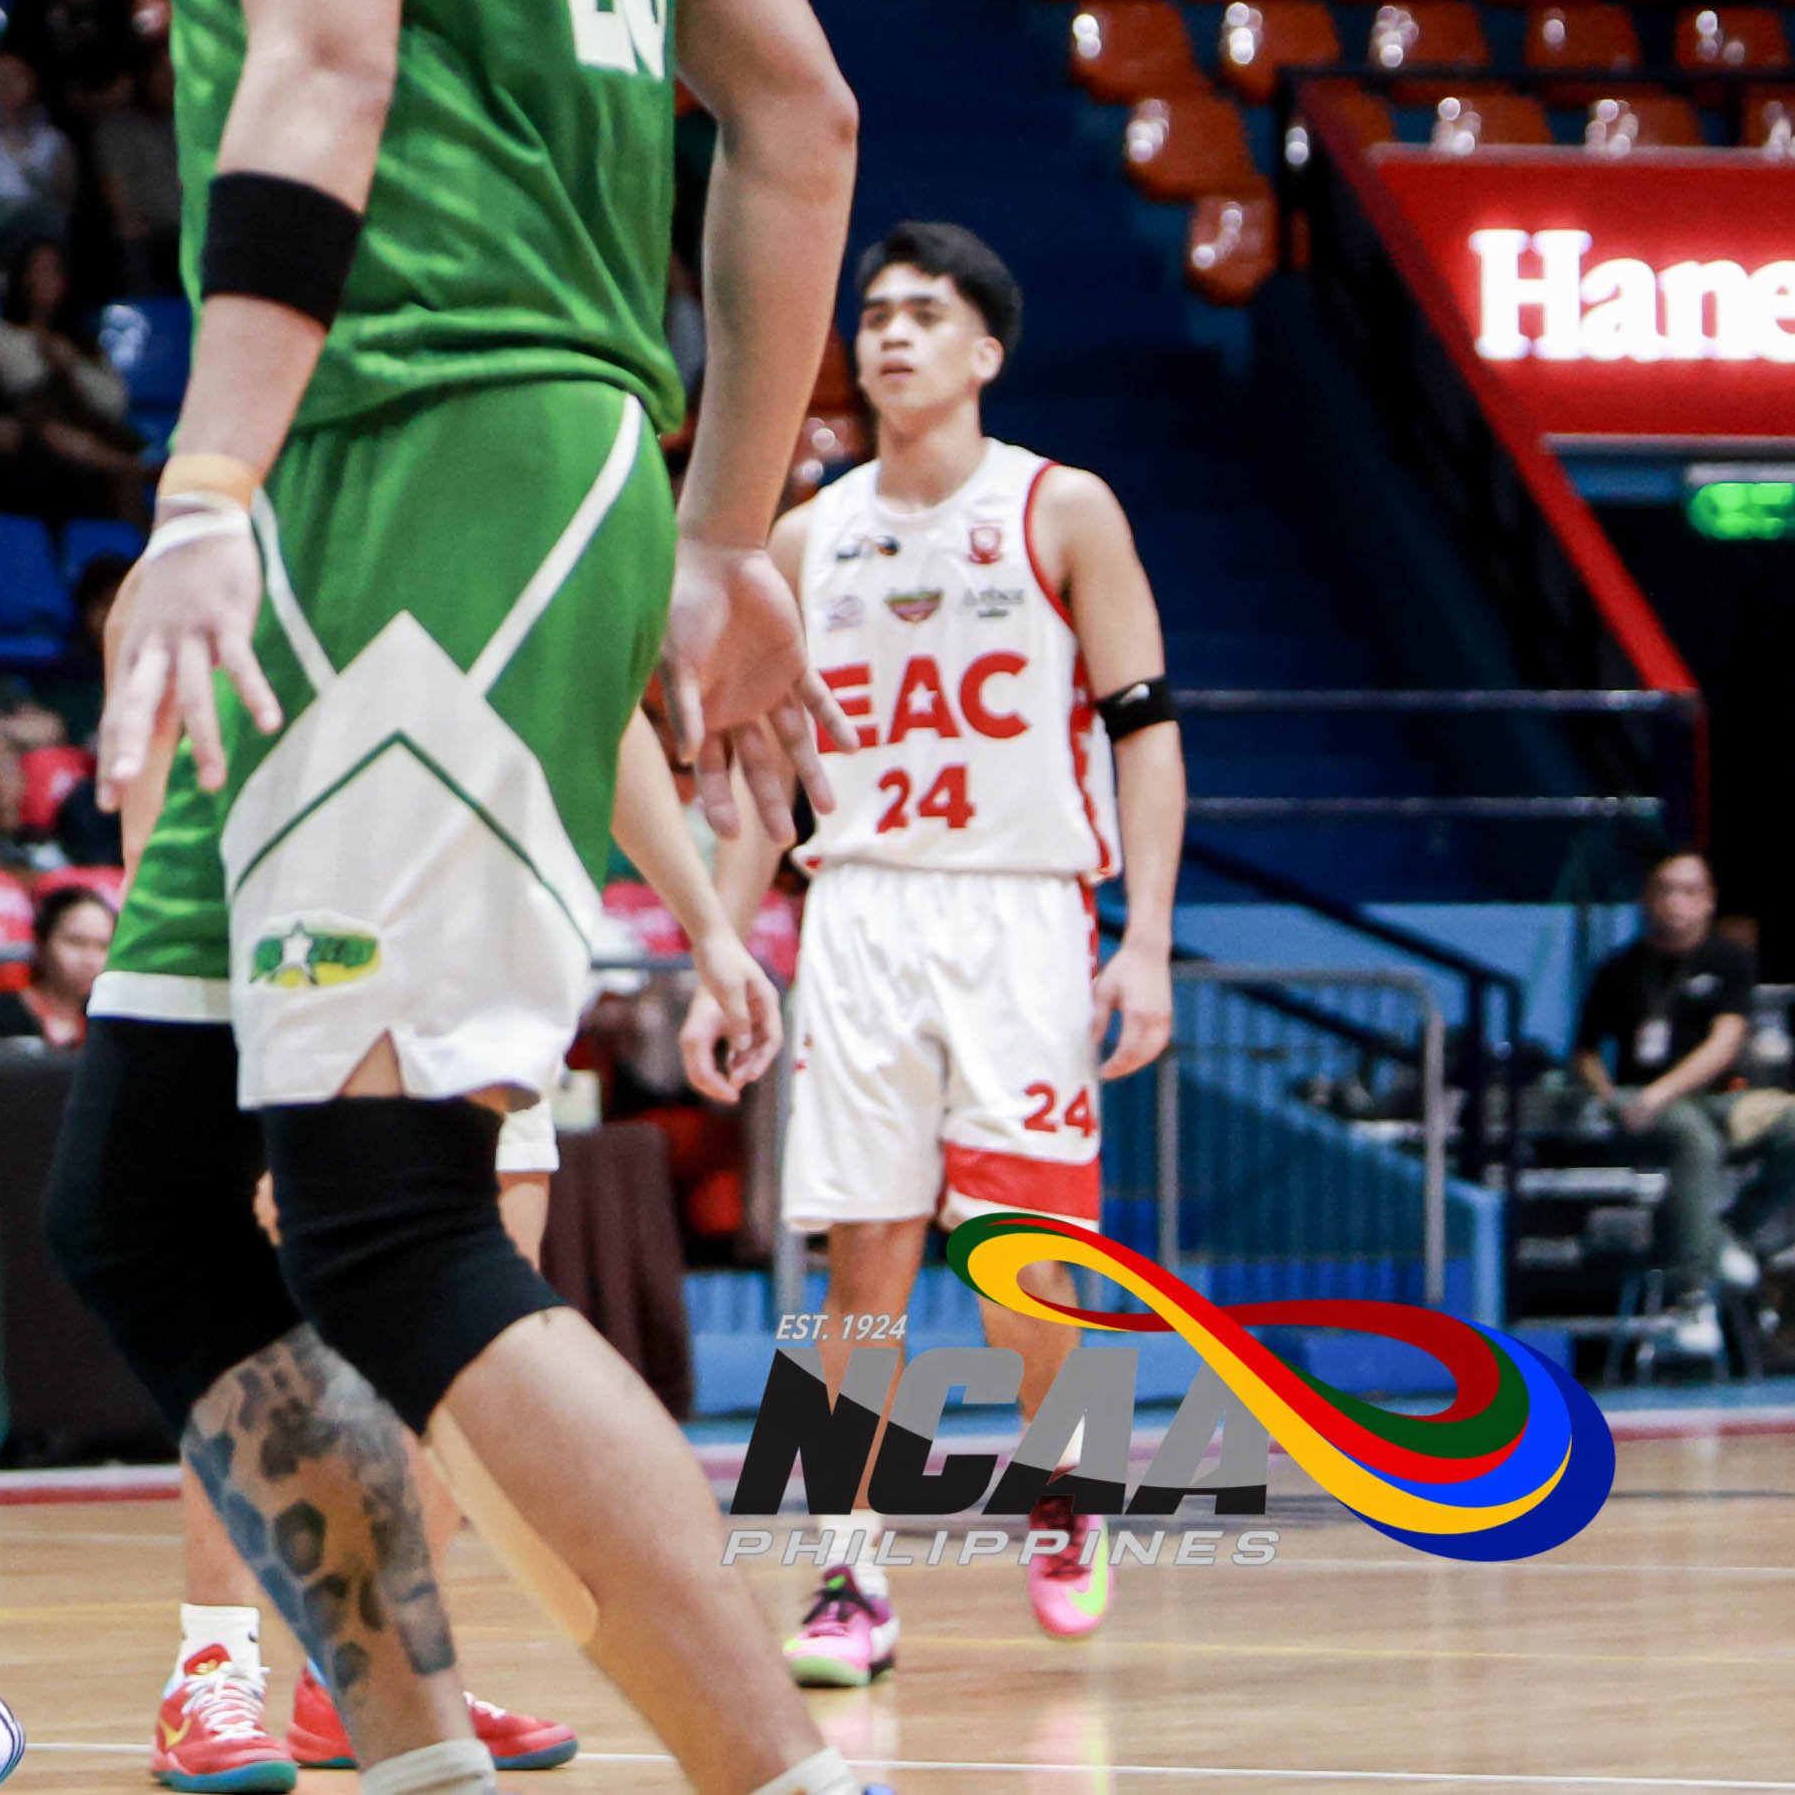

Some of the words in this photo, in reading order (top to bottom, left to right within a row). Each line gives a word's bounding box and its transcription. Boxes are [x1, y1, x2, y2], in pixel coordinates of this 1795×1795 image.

[815, 650, 1032, 755] EAC
[876, 765, 976, 834] 24
[1023, 1081, 1097, 1138] 24
